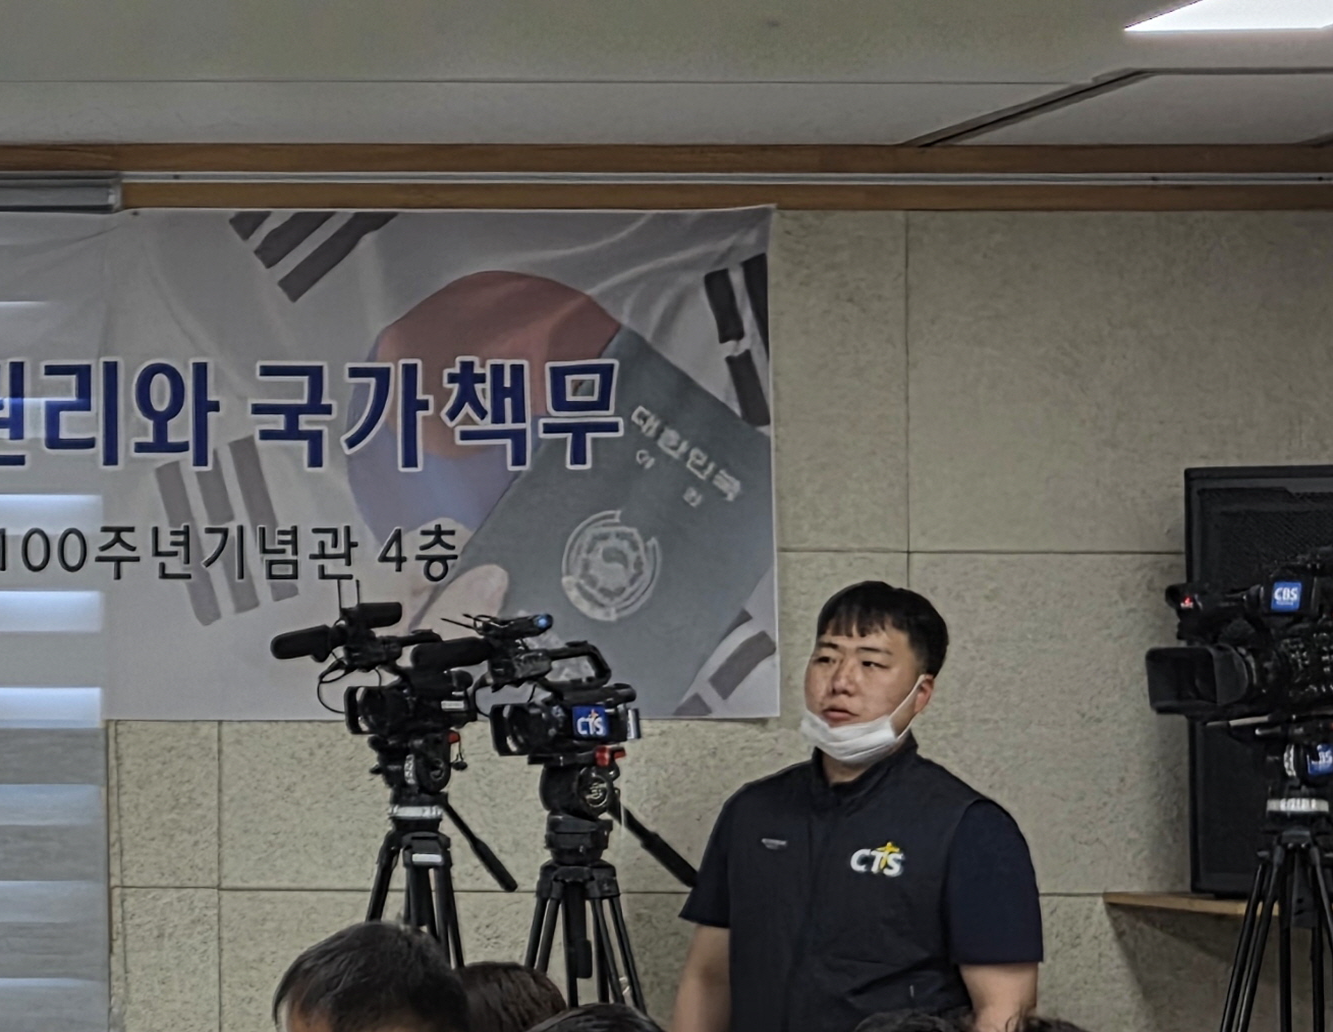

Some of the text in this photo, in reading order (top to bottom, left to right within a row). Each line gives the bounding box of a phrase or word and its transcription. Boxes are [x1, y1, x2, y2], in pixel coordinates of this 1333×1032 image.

[250, 358, 622, 469] 국가책무
[377, 523, 459, 582] 4층
[576, 715, 604, 735] CTS
[850, 845, 906, 877] CTS
